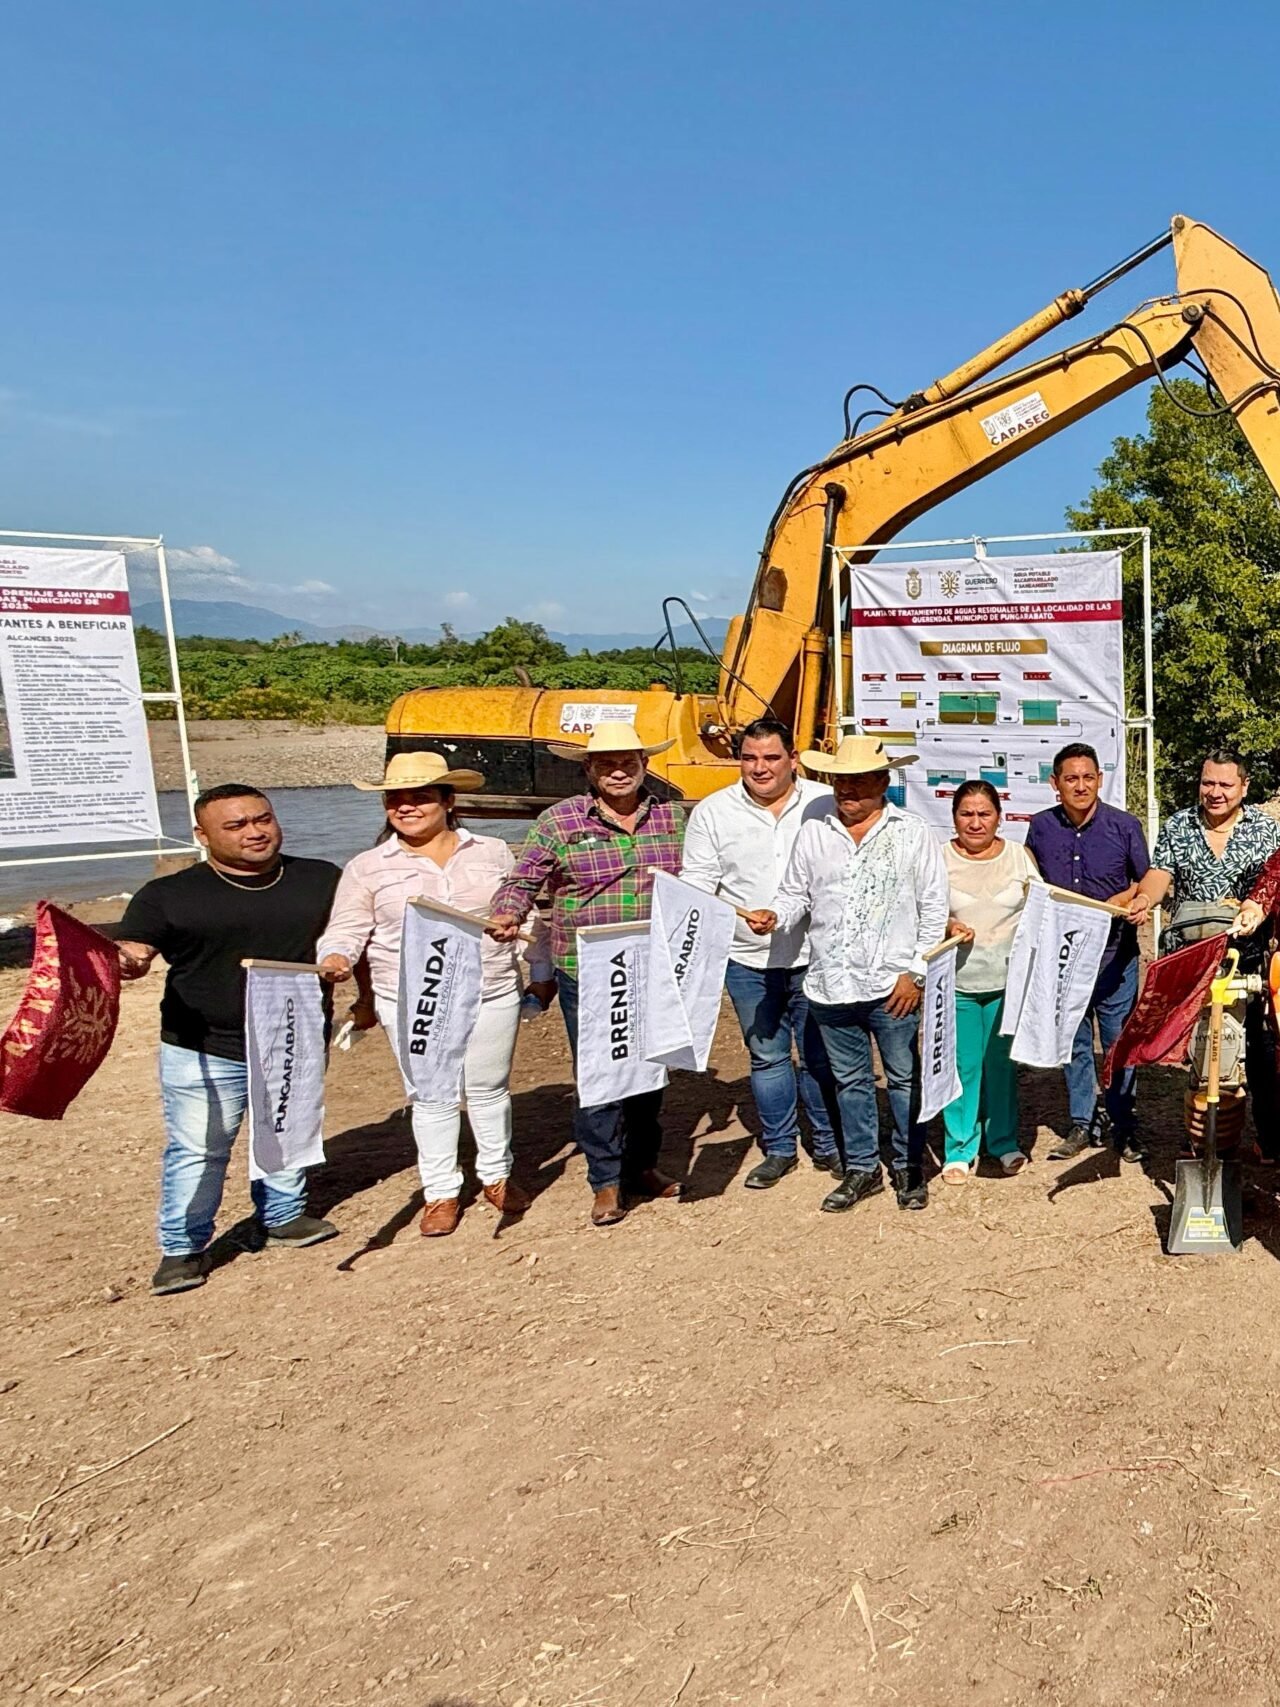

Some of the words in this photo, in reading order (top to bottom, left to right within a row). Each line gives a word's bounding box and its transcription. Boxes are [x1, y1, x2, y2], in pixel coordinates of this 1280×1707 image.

[991, 410, 1050, 446] CAPASEG
[965, 577, 998, 585] GUERRERO
[2, 588, 54, 598] DRENAJE
[57, 591, 115, 600] SANITARIO
[24, 597, 82, 605] MUNICIPIO
[898, 608, 943, 617] TRATAMIENTO
[944, 608, 953, 616] DE
[954, 607, 976, 615] AGUAS
[978, 605, 1018, 615] RESIDUALES
[1020, 605, 1029, 613] DE
[1043, 603, 1084, 612] LOCALIDAD
[1085, 602, 1094, 611] DE
[1096, 602, 1112, 611] LAS
[912, 616, 953, 624] QUERENDAS,
[954, 614, 988, 622] MUNICIPIO
[1000, 612, 1055, 620] PUNGARABATO.
[46, 620, 56, 629] A
[58, 620, 127, 630] BENEFICIAR
[7, 634, 52, 642] ALCANCES
[942, 643, 982, 654] DIAGRAMA
[984, 642, 995, 653] DE
[996, 641, 1021, 653] FLUJO
[410, 937, 449, 1056] BRENDA
[610, 950, 629, 1061] BRENDA
[933, 974, 944, 1076] BRENDA
[274, 998, 295, 1133] PUNGARABATO
